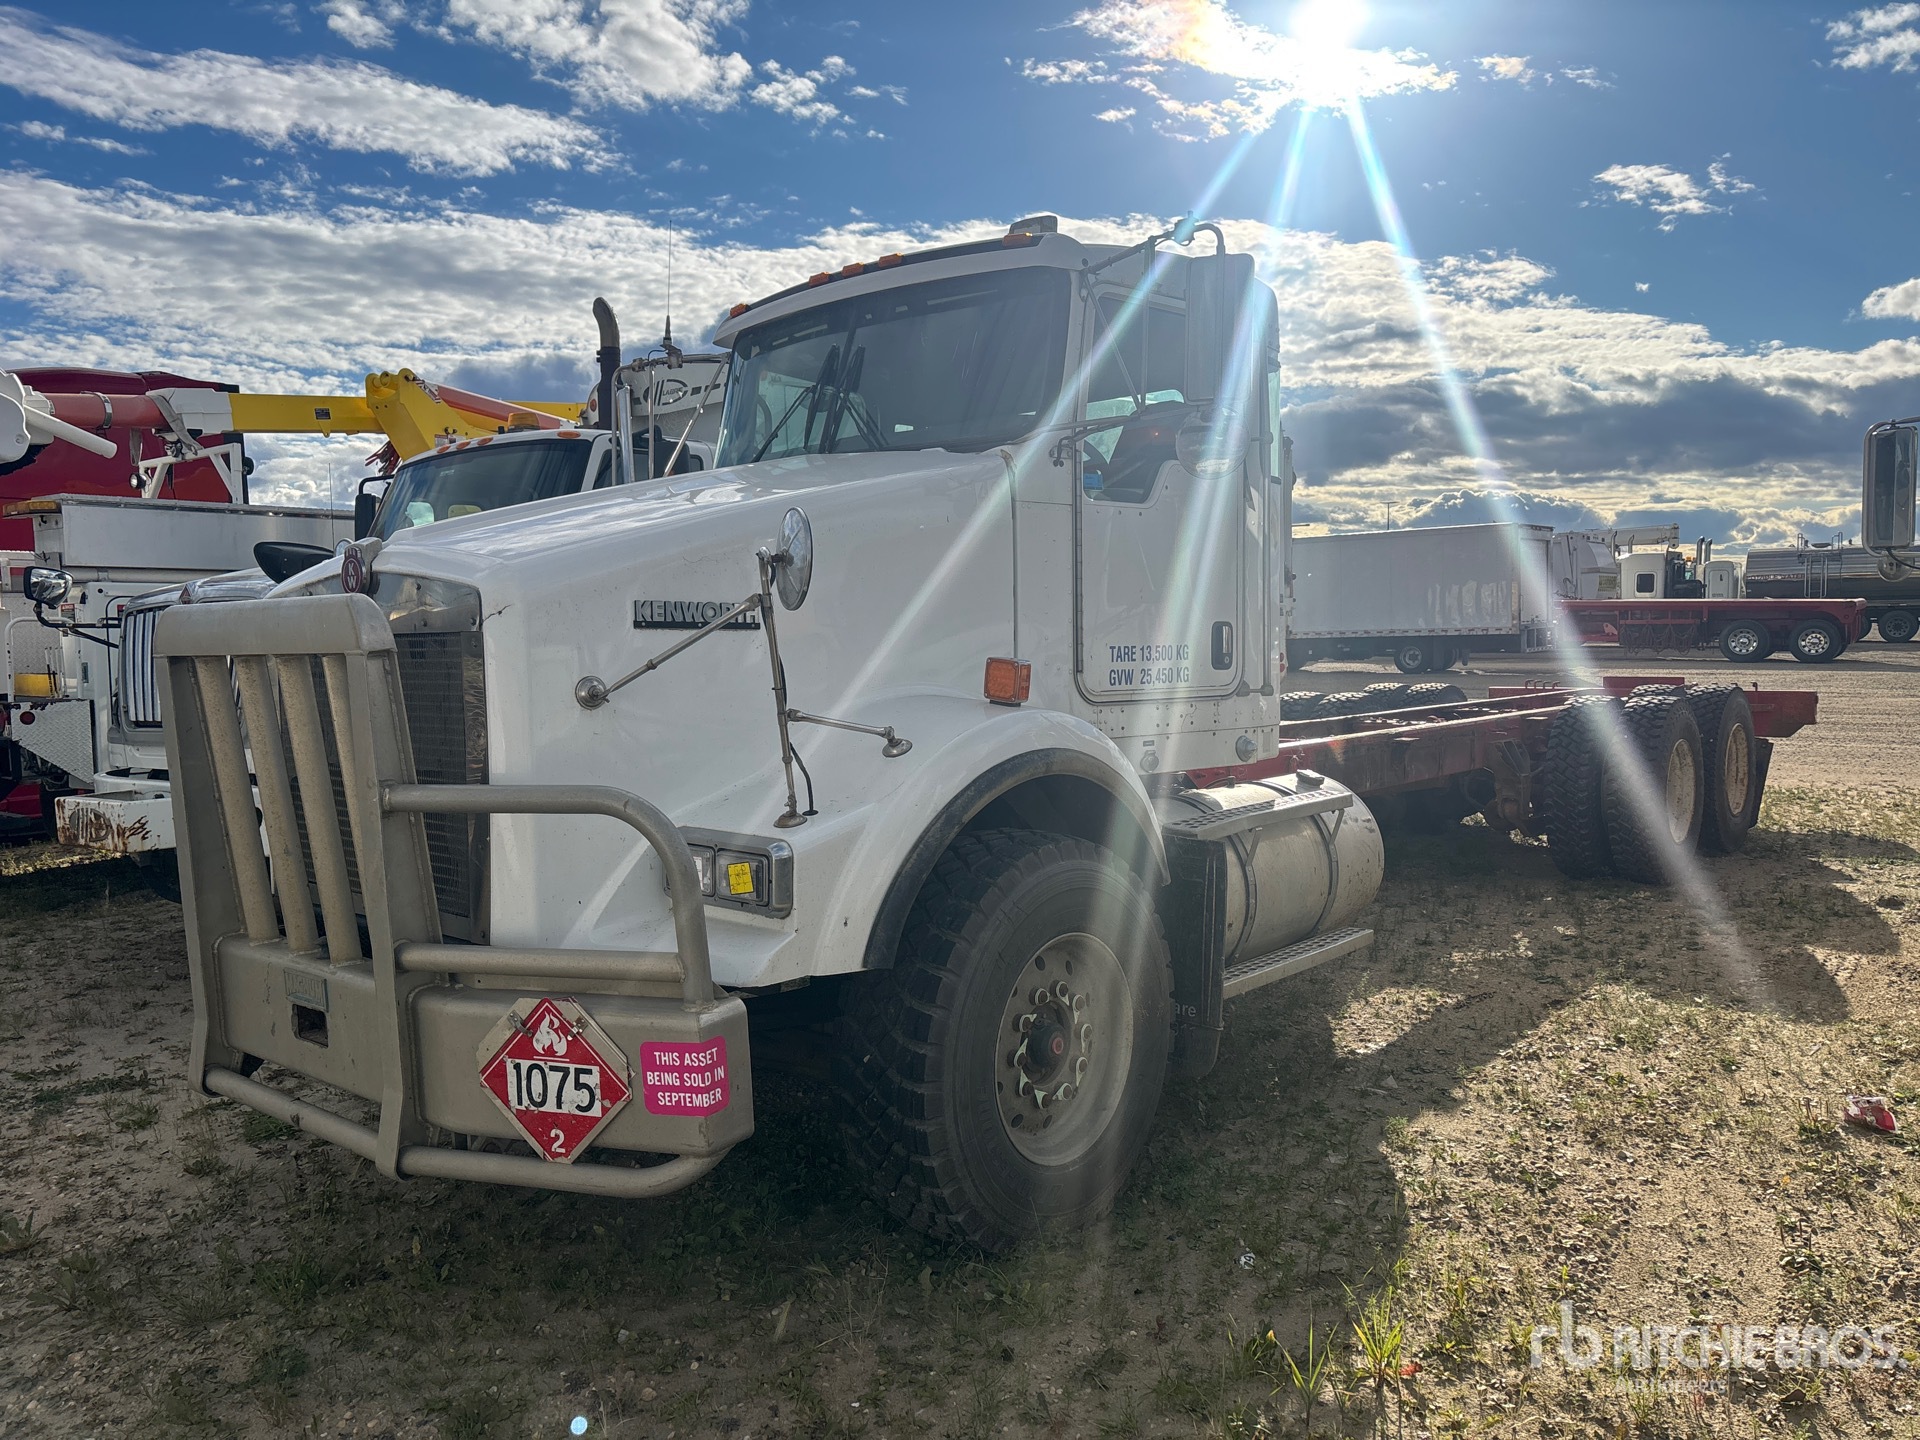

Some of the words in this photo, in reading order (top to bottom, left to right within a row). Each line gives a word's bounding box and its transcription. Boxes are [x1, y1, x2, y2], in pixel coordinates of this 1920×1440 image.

[1109, 645, 1137, 662] TARE
[1140, 644, 1173, 663] 13,500
[1176, 644, 1189, 661] KG
[1109, 668, 1134, 686] GVW
[1140, 667, 1174, 687] 25,450
[1176, 666, 1190, 683] KG
[653, 1051, 680, 1066] THIS
[684, 1047, 718, 1067] ASSET
[646, 1071, 681, 1086] BEING
[683, 1071, 712, 1087] SOLD
[714, 1065, 725, 1082] IN
[512, 1062, 596, 1113] 1075
[657, 1087, 723, 1108] SEPTEMBER
[550, 1128, 566, 1154] 2
